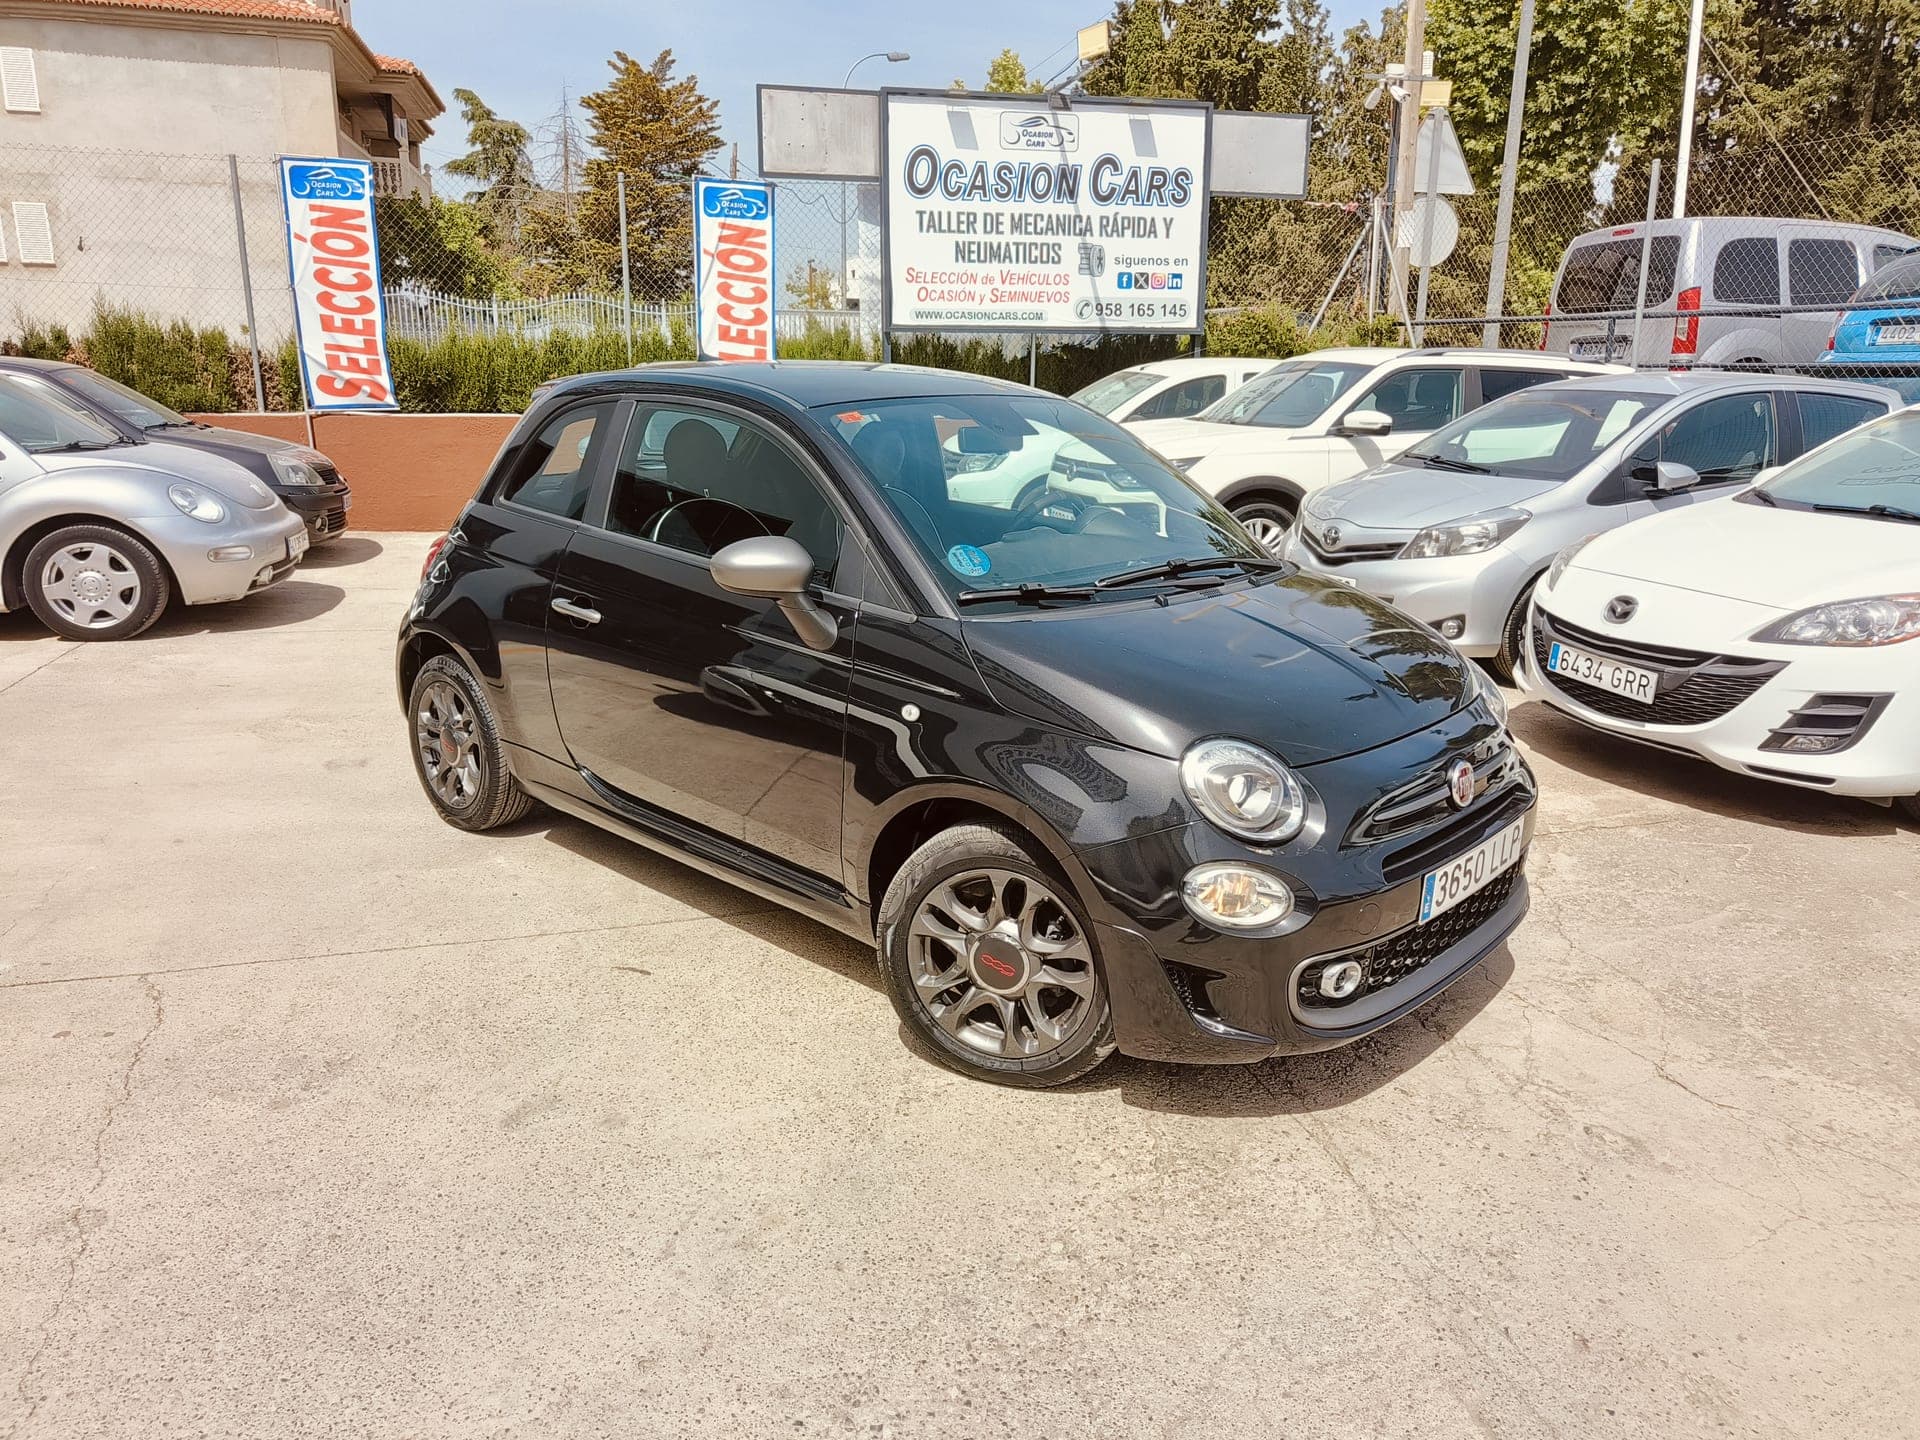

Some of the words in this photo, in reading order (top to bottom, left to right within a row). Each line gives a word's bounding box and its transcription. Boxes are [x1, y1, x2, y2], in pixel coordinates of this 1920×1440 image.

[1026, 139, 1045, 147] CARS
[904, 145, 1082, 203] OCASION
[1089, 153, 1193, 207] CARS
[915, 210, 978, 235] TALLER
[983, 212, 1005, 235] DE
[1010, 212, 1094, 237] MECANICA
[1099, 211, 1158, 239] RÁPIDA
[1162, 217, 1174, 239] Y
[954, 240, 1062, 265] NEUMATICOS
[1173, 257, 1189, 267] en
[905, 267, 978, 285] SELECCIÓN
[981, 274, 995, 285] de
[999, 269, 1070, 286] VEHÍCULOS
[293, 203, 388, 402] SELECCIÓN
[917, 286, 976, 303] OCASIÓN
[978, 293, 986, 305] y
[989, 287, 1070, 304] SEMINUEVOS
[915, 310, 1044, 321] WWW.OCASIONCARS.COM
[1094, 302, 1123, 318] 958
[1128, 303, 1155, 318] 165
[1160, 303, 1187, 318] 145
[1881, 325, 1916, 340] 4402
[1560, 650, 1603, 683] 6434
[1610, 666, 1650, 698] GRR
[1435, 848, 1485, 907] 3650
[1490, 824, 1520, 875] LLP
